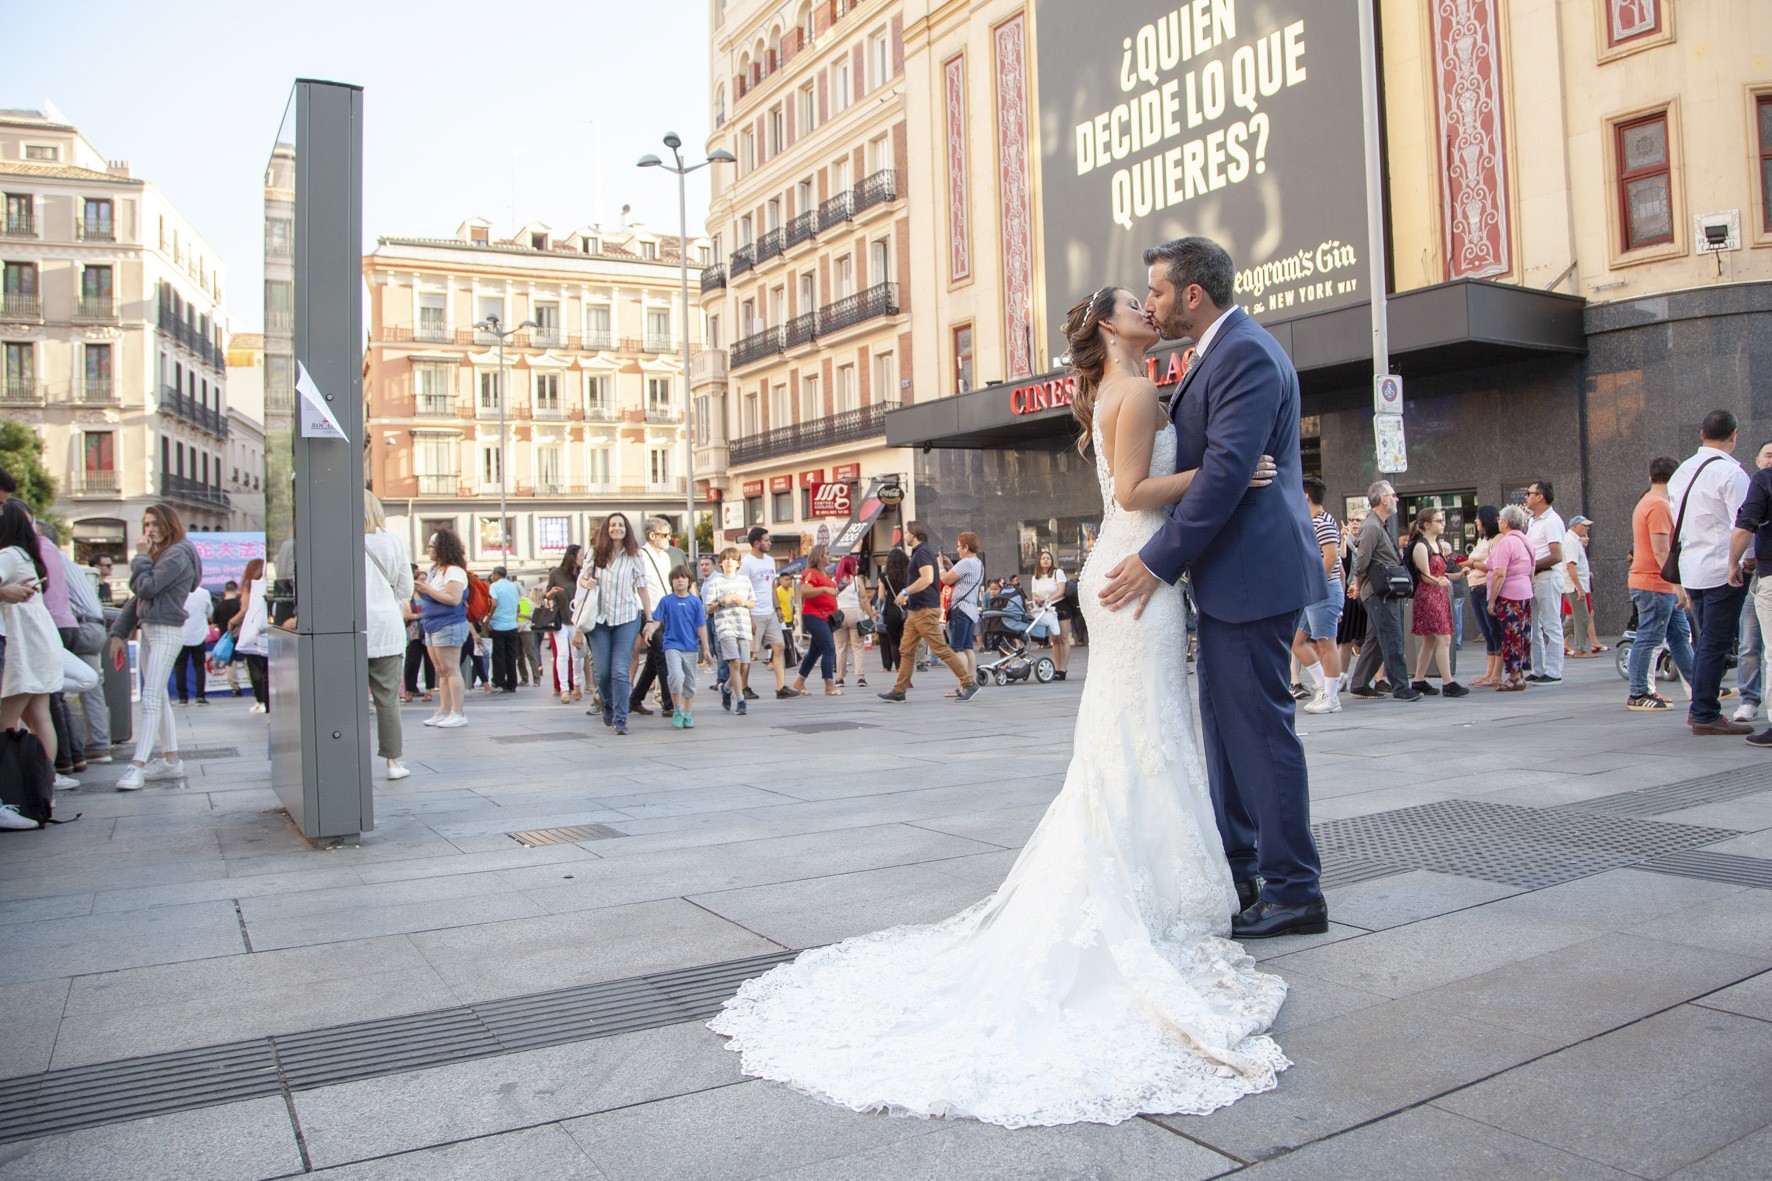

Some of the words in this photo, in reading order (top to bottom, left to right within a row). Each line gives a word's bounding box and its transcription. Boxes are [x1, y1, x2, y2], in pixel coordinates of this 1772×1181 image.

[1076, 79, 1180, 176] DECIDE
[1185, 59, 1225, 129] LO
[1232, 19, 1307, 113] QUE
[1111, 112, 1270, 231] QUIERES?
[1233, 249, 1314, 297] eagram's
[1315, 240, 1357, 273] Gin
[1269, 289, 1295, 311] NEW
[1299, 280, 1333, 304] YORK
[1337, 278, 1357, 294] WAY
[840, 532, 860, 542] DOG
[845, 522, 868, 533] HOT
